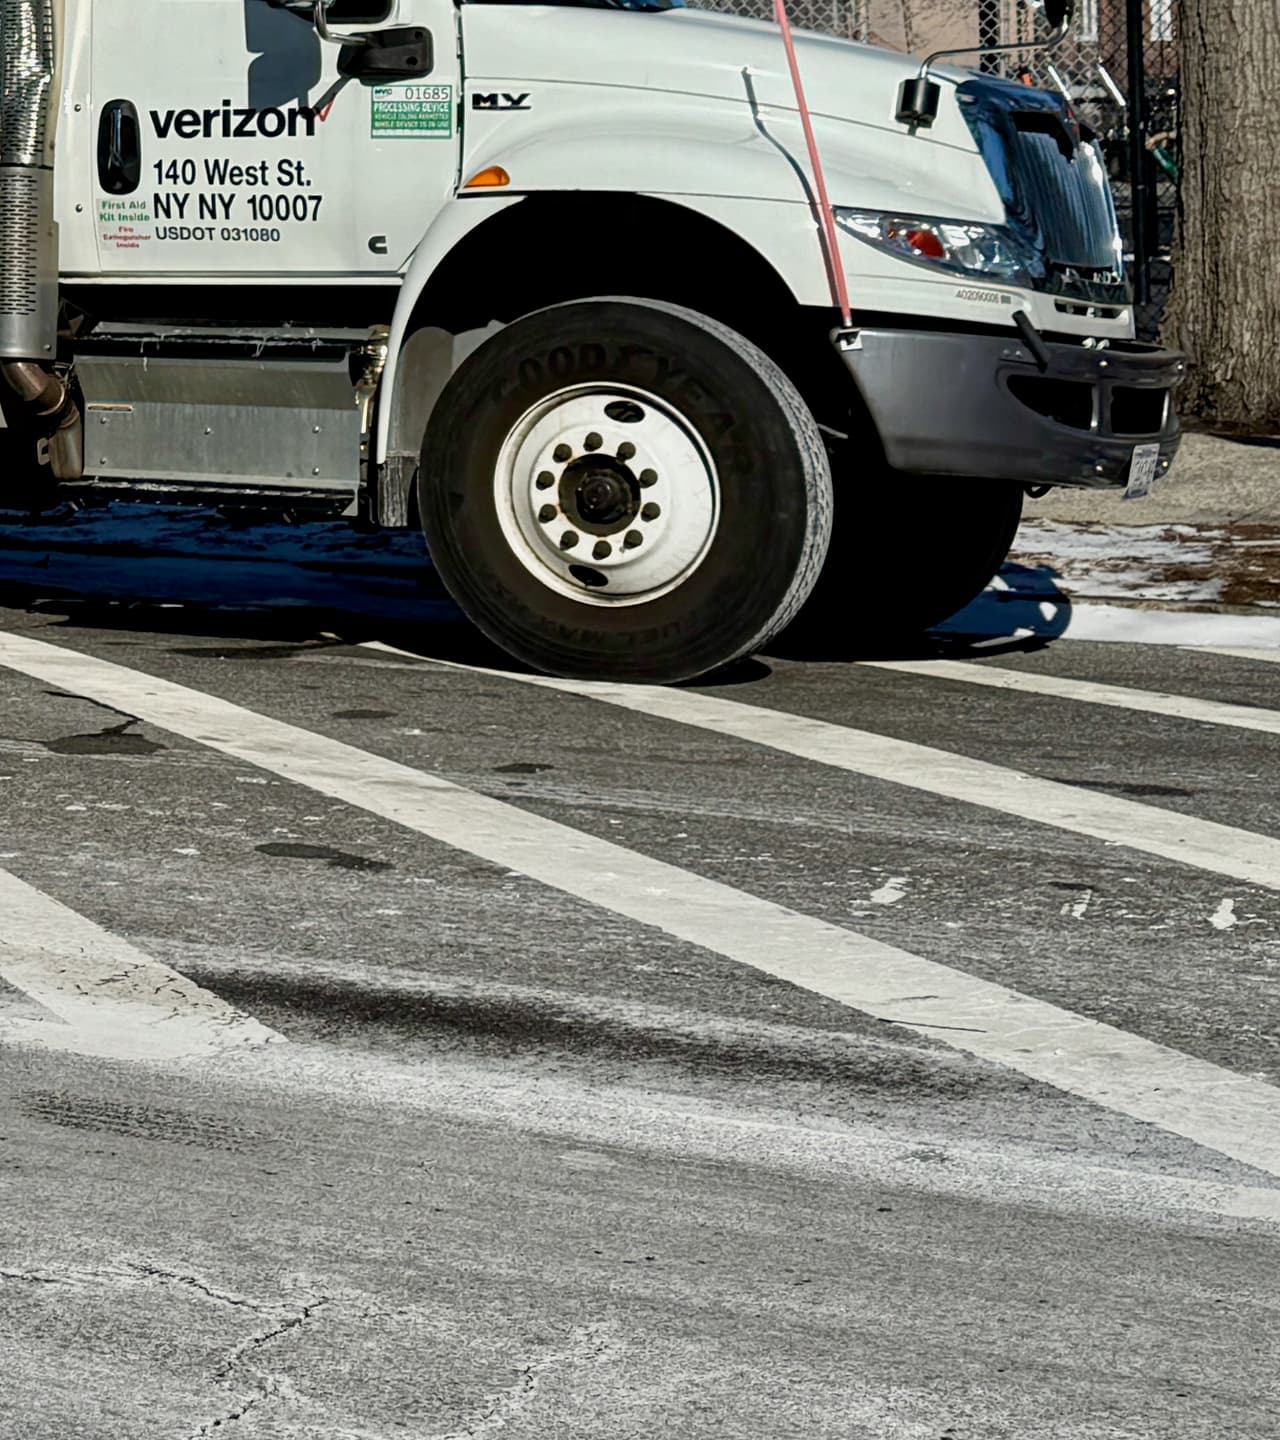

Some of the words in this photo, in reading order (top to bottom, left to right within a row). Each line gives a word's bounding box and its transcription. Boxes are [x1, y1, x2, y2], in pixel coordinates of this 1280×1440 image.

[405, 87, 449, 100] 01685
[148, 99, 316, 139] verizon
[153, 158, 196, 186] 140
[204, 158, 270, 187] West
[277, 158, 312, 187] St.
[102, 200, 126, 210] First
[129, 200, 146, 209] Aid
[153, 192, 190, 220] NY
[198, 193, 236, 220] NY
[247, 194, 323, 222] 10007
[99, 212, 115, 221] Kit
[118, 212, 150, 221] Inside
[154, 226, 216, 241] USDOT
[220, 227, 281, 242] 031080
